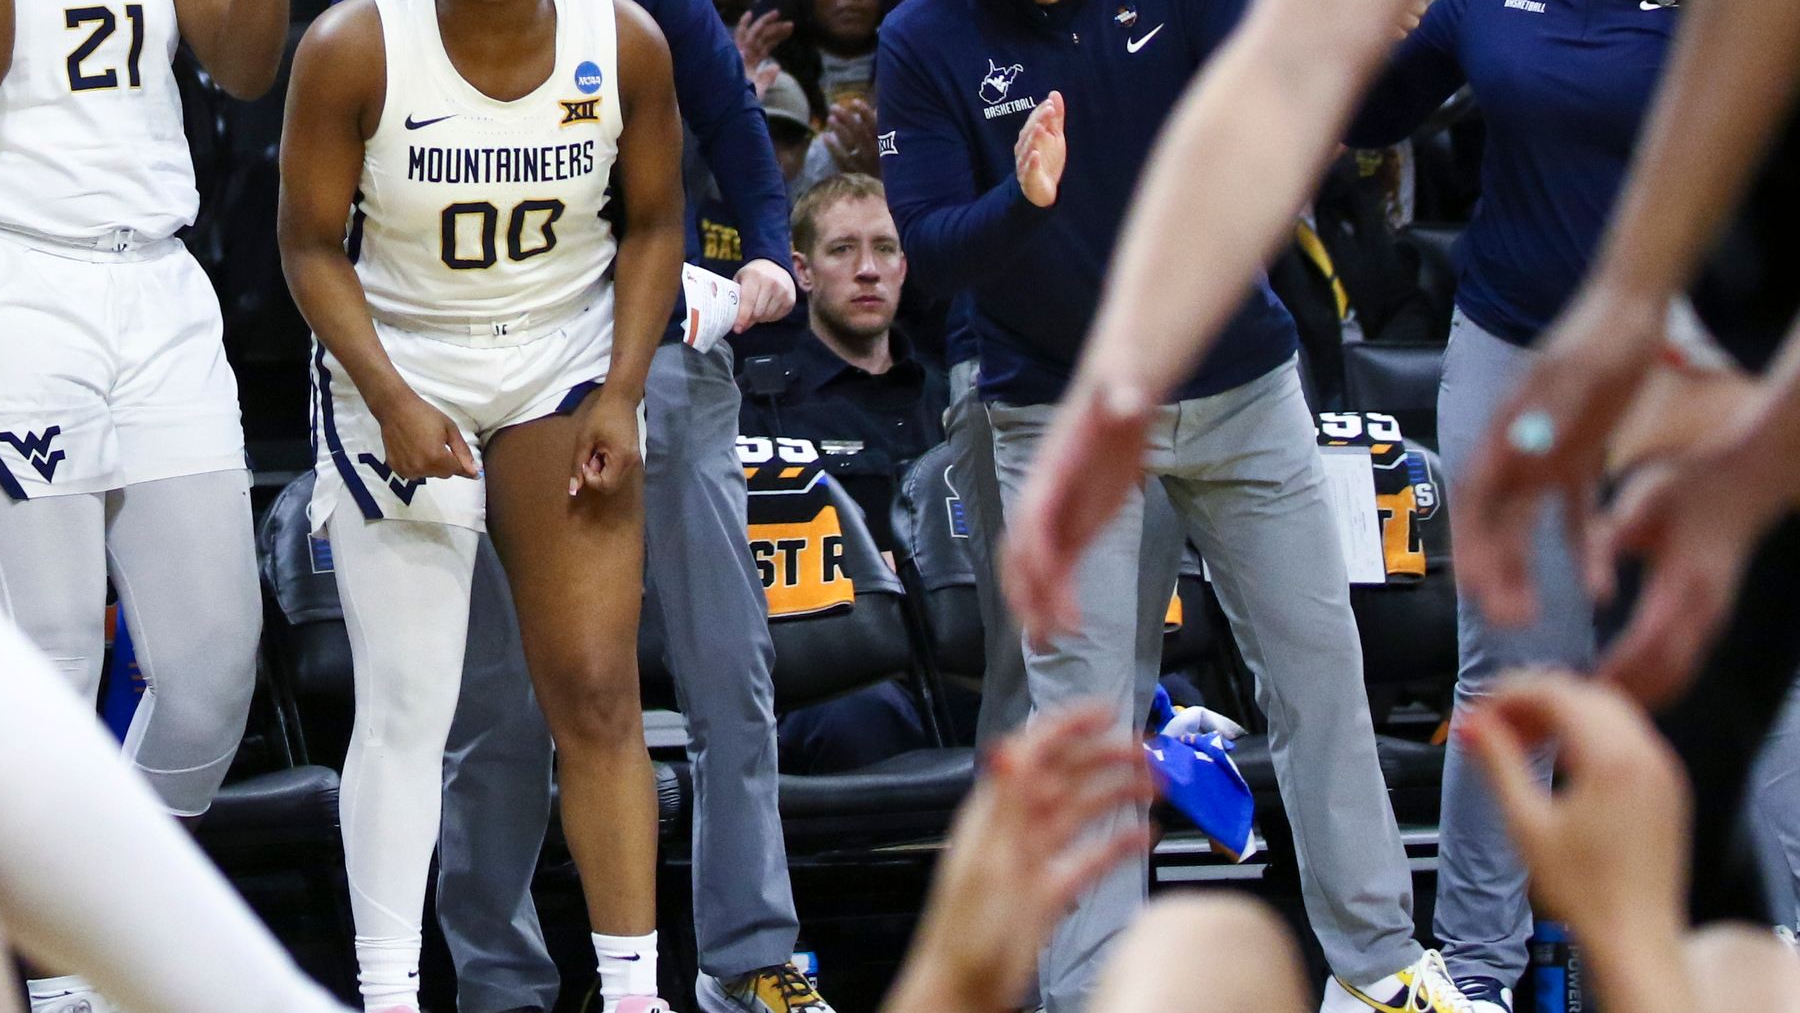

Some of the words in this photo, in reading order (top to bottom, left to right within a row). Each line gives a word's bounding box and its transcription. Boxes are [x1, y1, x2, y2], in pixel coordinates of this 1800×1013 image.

[64, 3, 145, 93] 21
[983, 96, 1037, 120] BASKETBALL
[408, 140, 594, 184] MOUNTAINEERS
[440, 198, 566, 270] 00
